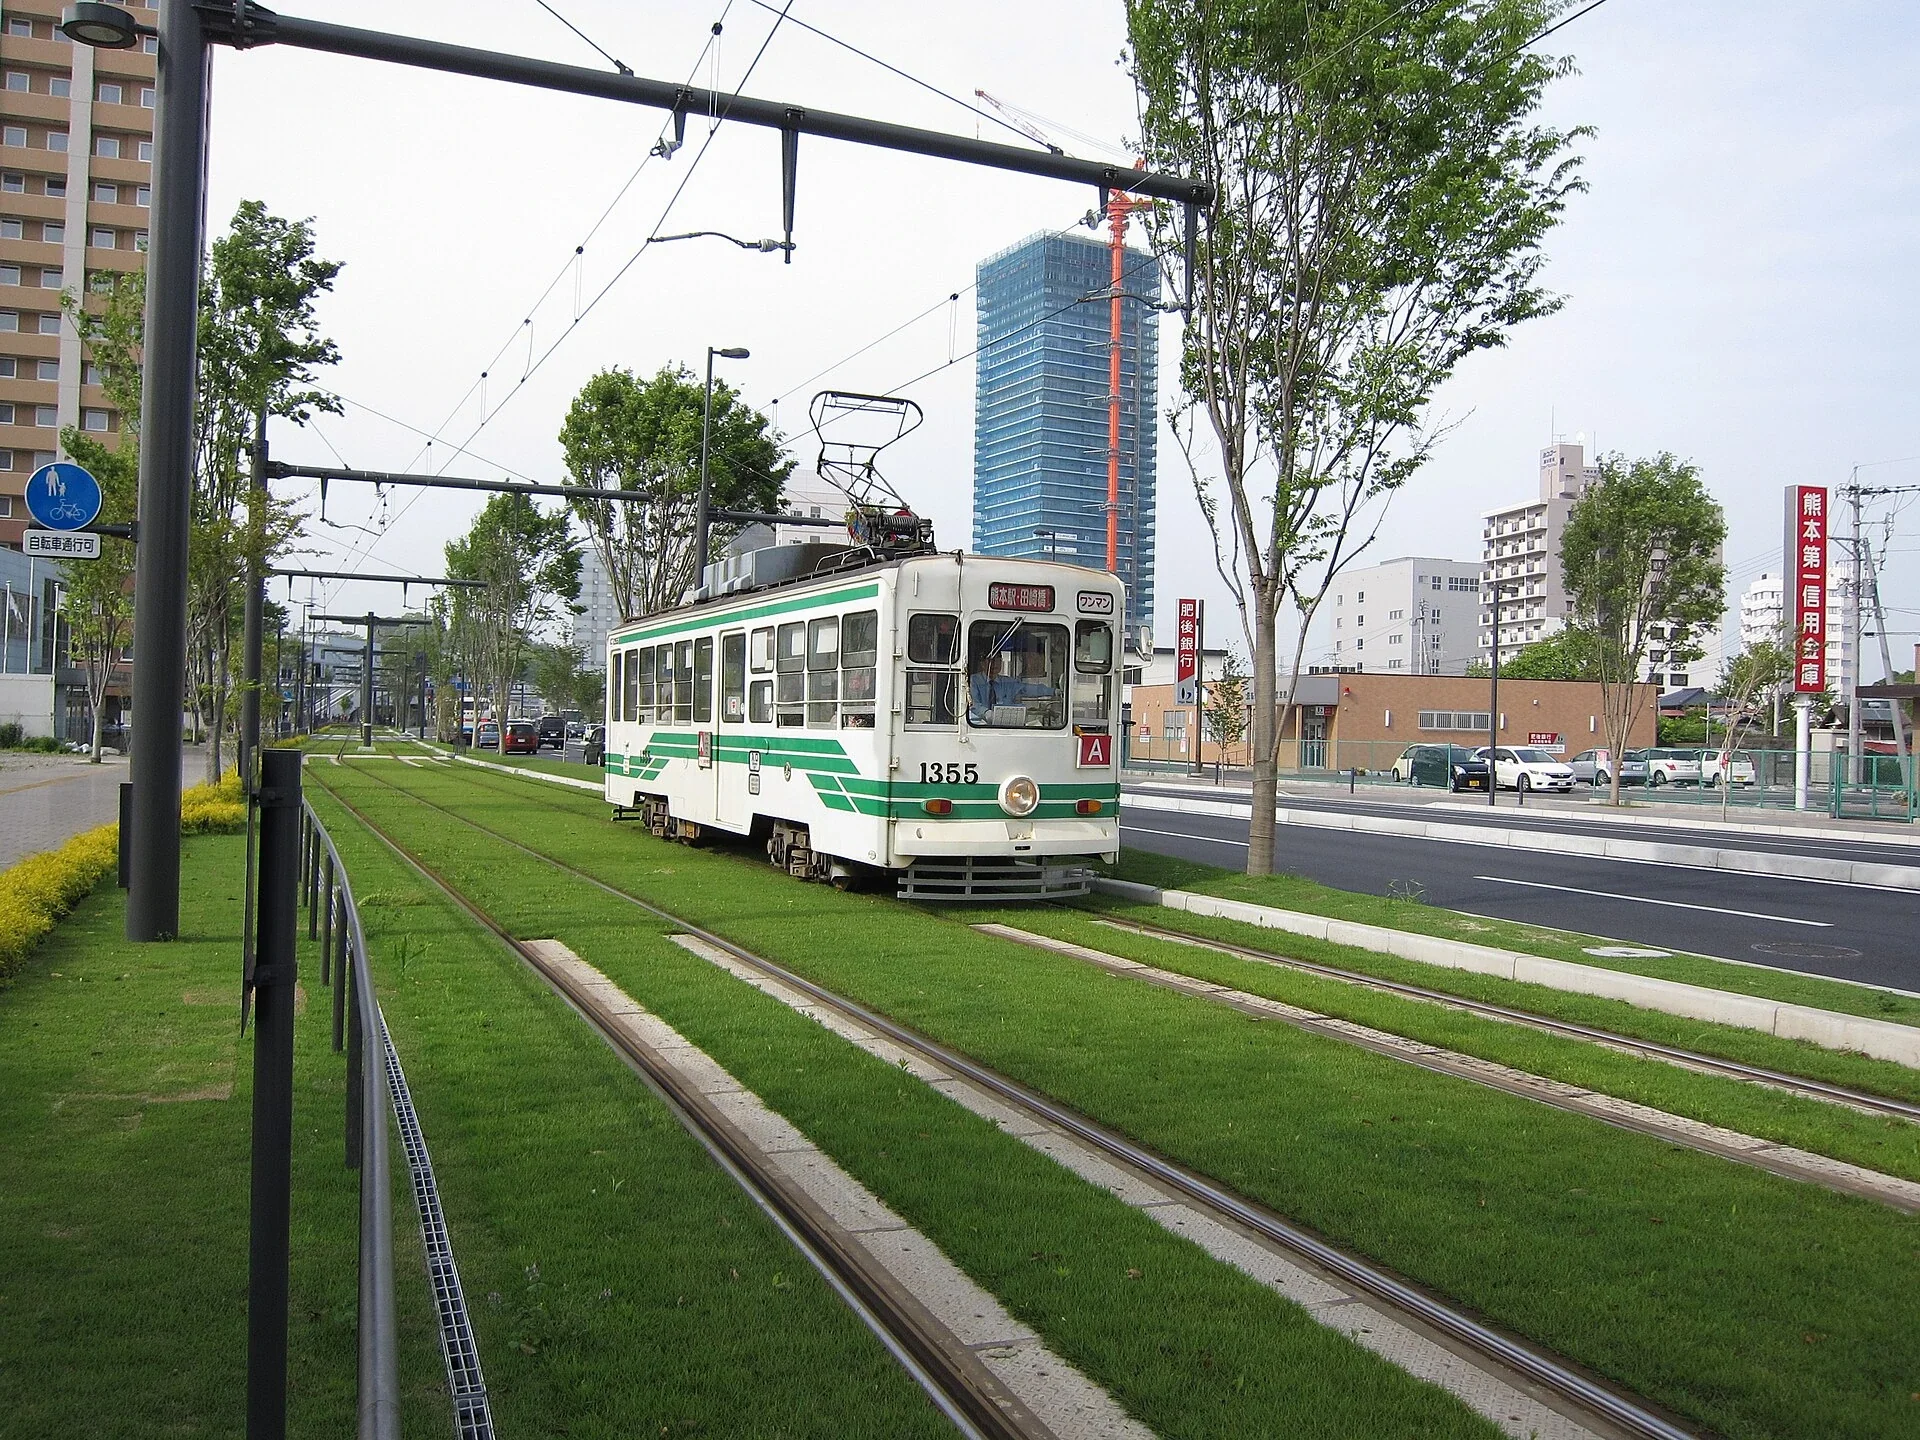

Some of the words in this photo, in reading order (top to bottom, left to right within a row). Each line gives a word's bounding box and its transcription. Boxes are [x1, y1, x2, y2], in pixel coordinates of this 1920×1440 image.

[29, 536, 95, 553] 自転車通行可
[1800, 491, 1822, 687] 熊本第一信用金庫
[1079, 596, 1110, 609] ワンマン
[1179, 603, 1194, 668] 肥後銀行
[1087, 739, 1103, 763] A
[919, 763, 979, 785] 1355
